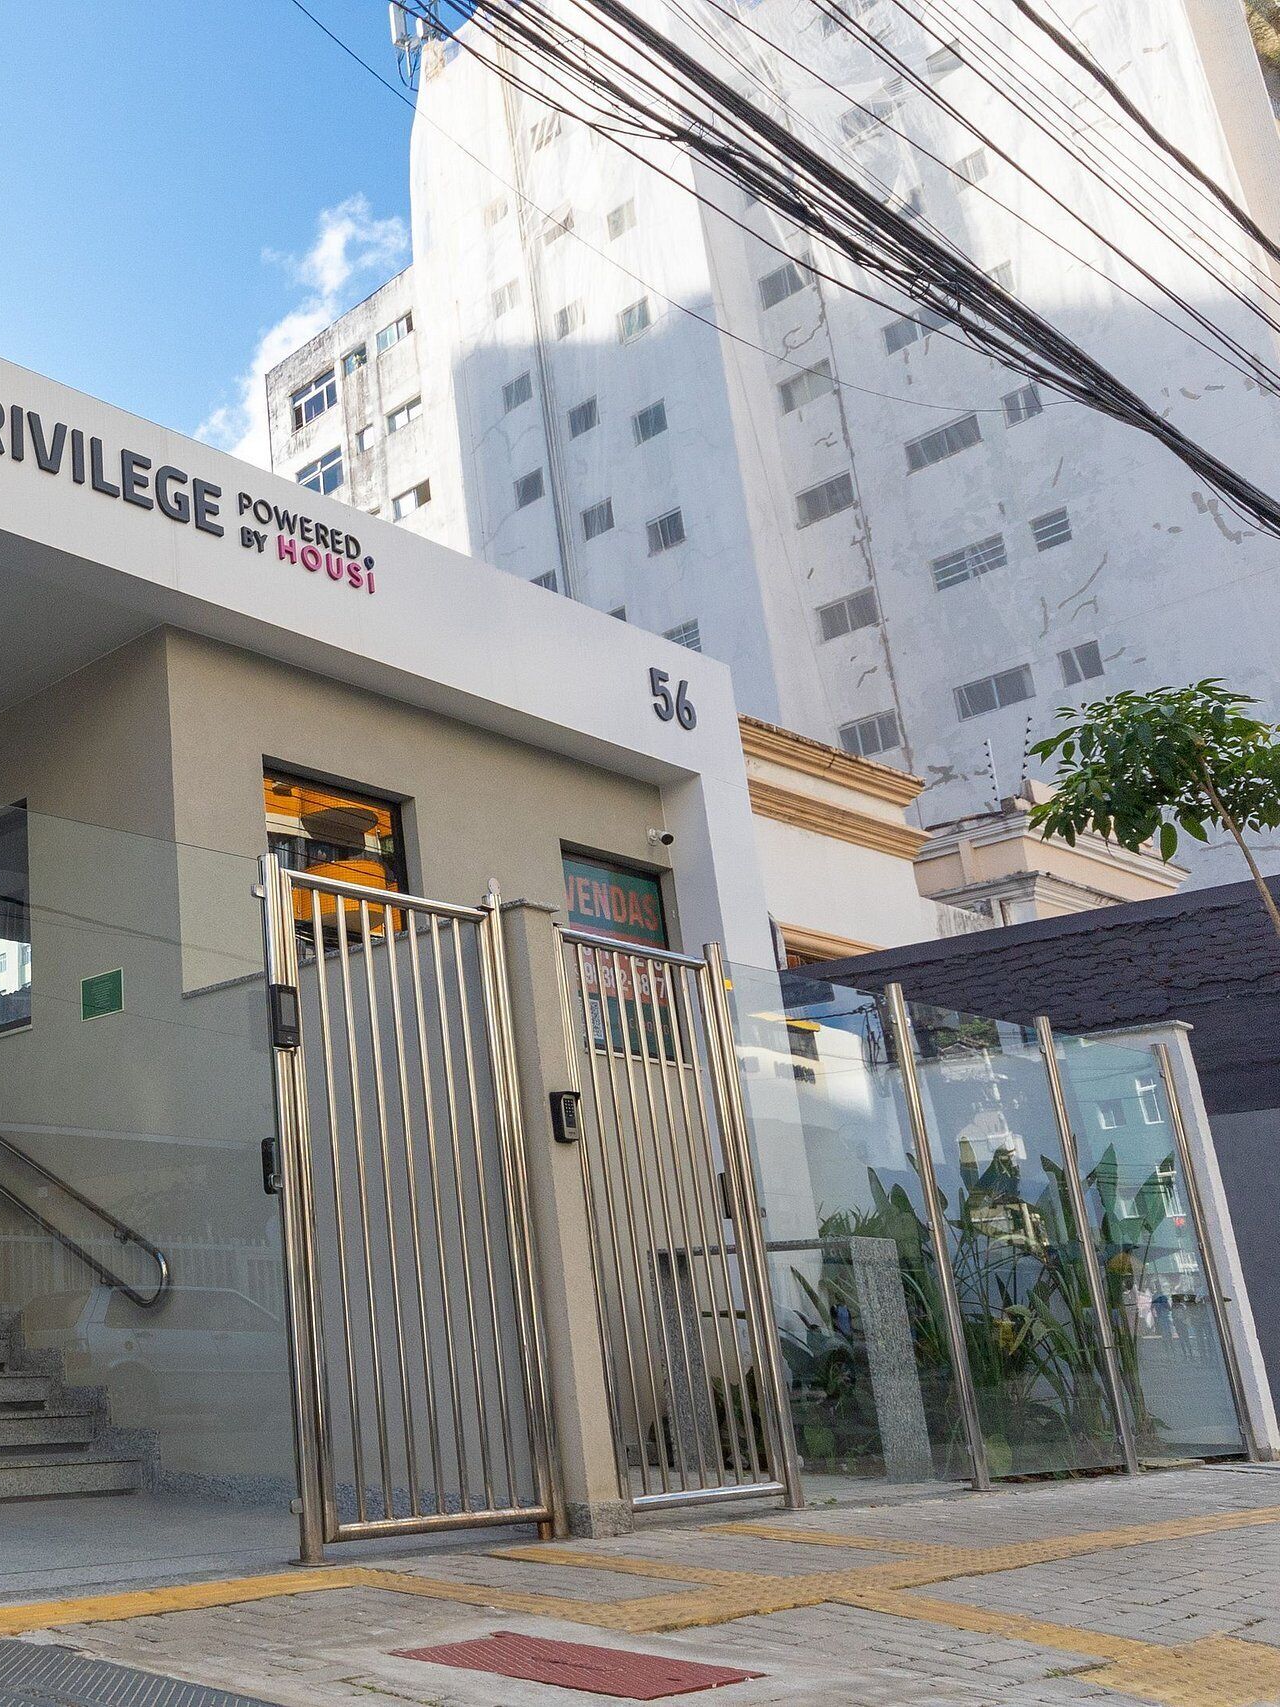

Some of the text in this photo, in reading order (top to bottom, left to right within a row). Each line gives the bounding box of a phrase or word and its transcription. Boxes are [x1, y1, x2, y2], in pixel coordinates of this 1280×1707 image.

[237, 491, 362, 560] POWERED
[240, 525, 269, 554] BY
[649, 667, 697, 731] 56
[563, 873, 659, 931] VENDAS
